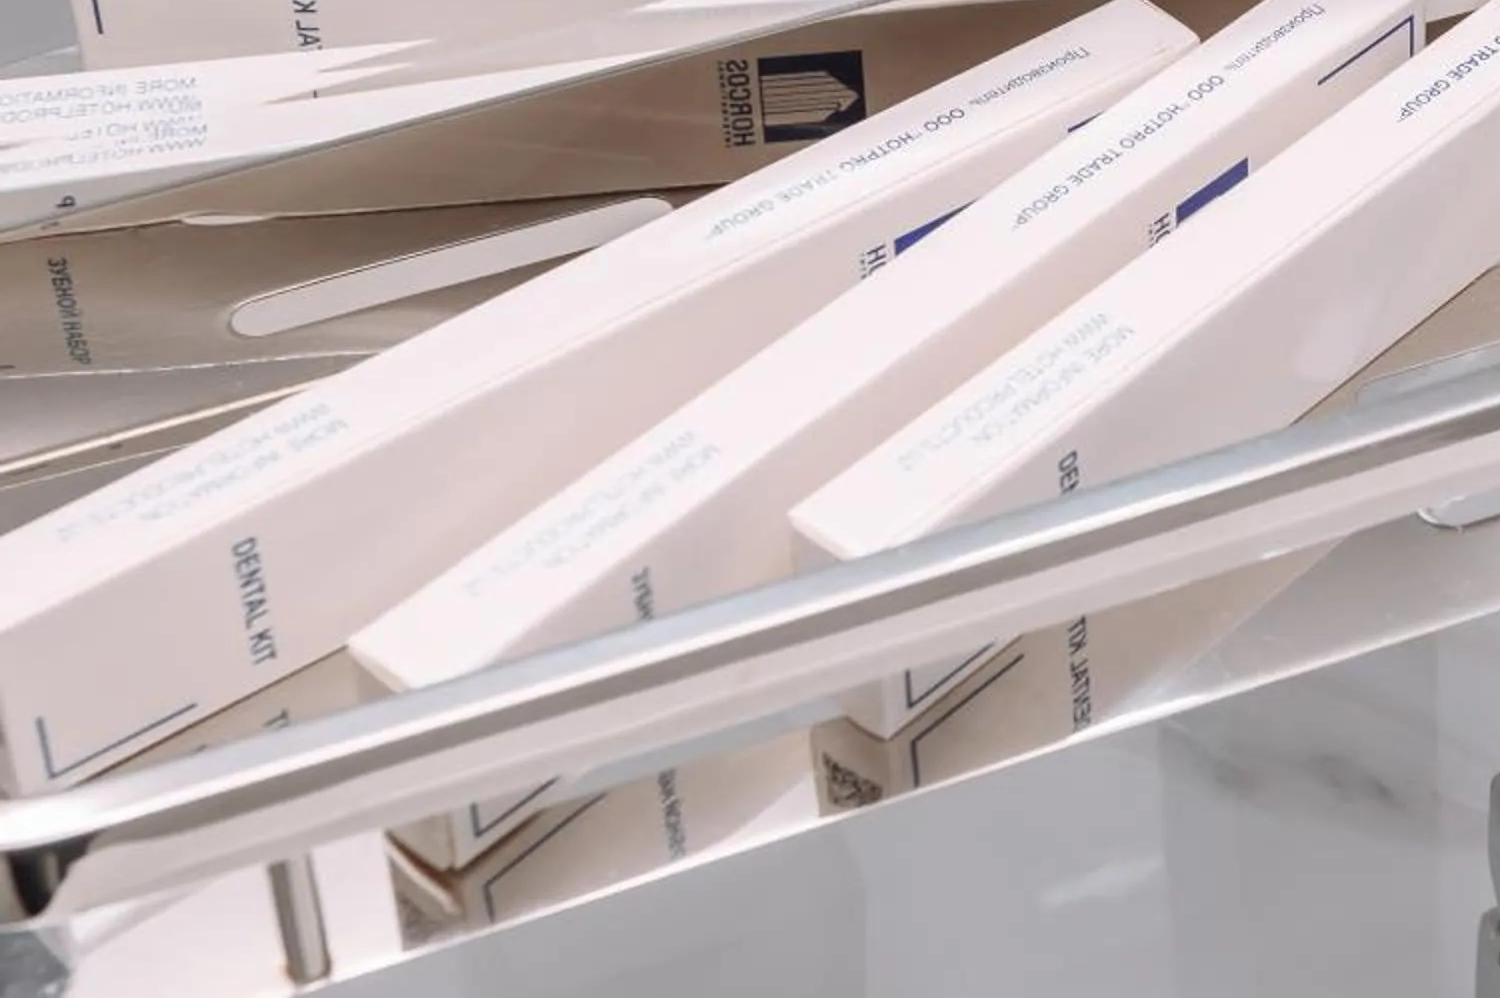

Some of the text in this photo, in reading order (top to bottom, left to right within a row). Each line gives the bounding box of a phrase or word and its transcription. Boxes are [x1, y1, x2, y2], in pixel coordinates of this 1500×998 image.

[1449, 46, 1496, 80] TRADE
[1069, 150, 1117, 184] TRADE
[231, 537, 277, 664] DENTAL KIT
